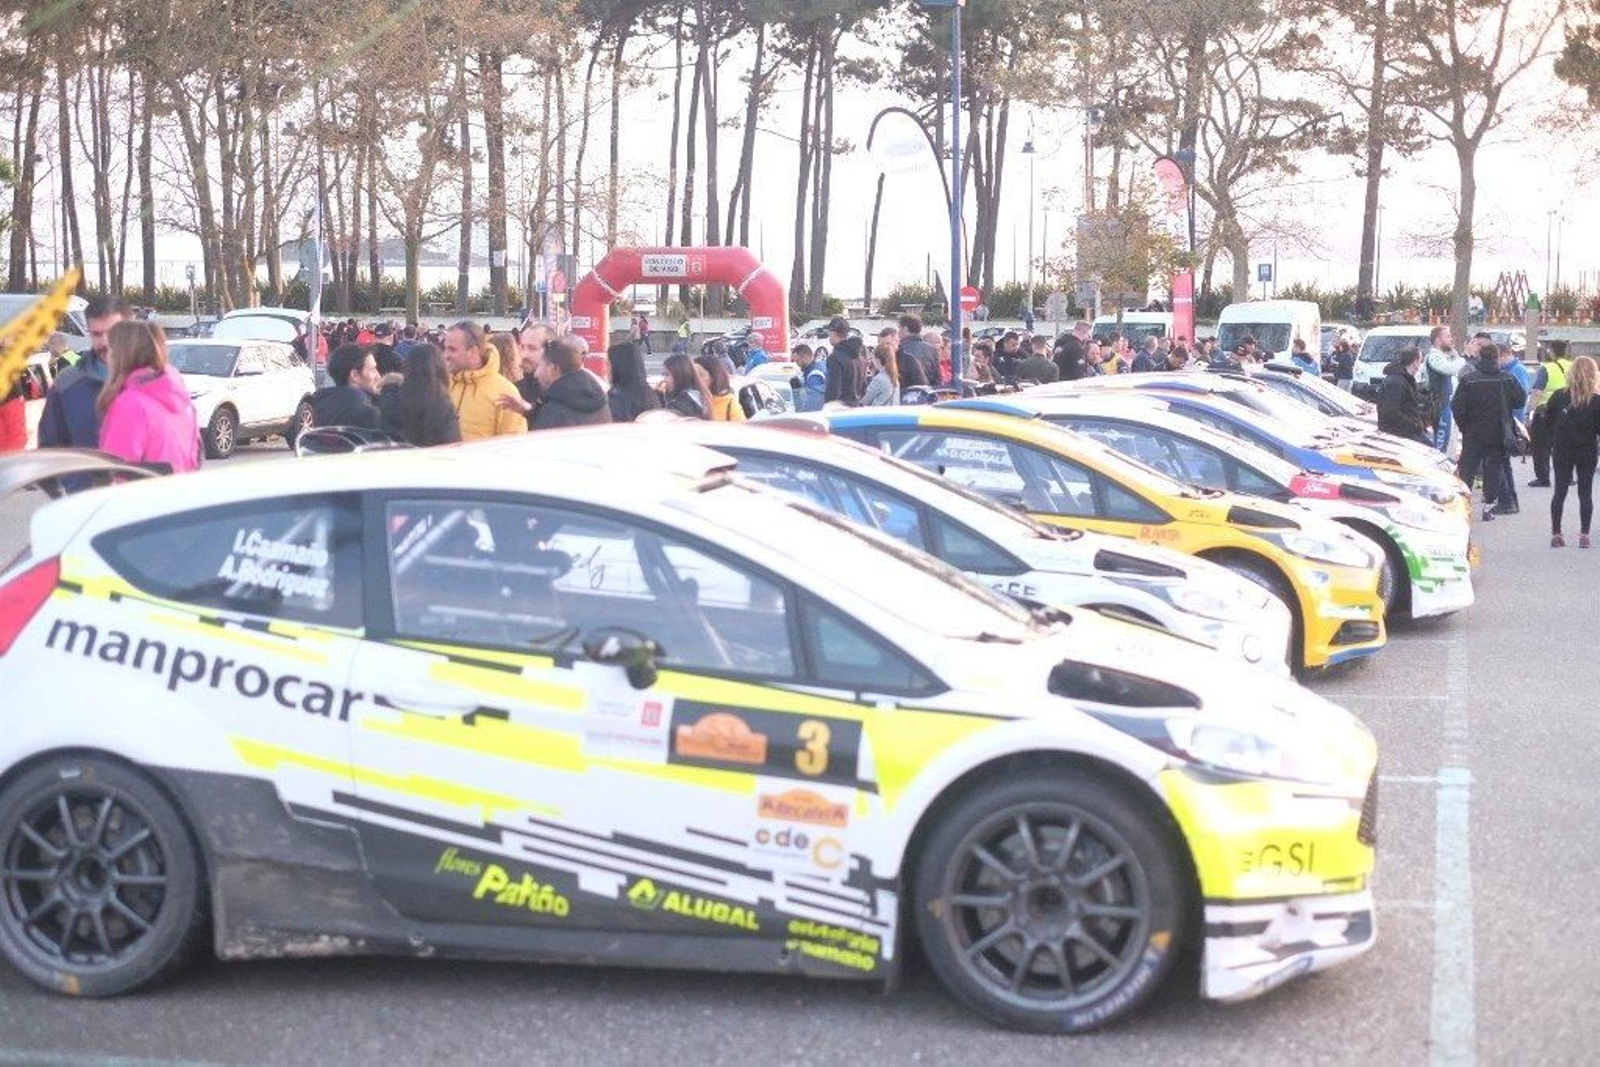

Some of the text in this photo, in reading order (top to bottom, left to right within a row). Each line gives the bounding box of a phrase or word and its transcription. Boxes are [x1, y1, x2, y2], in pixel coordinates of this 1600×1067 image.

[45, 617, 364, 722] manprocar
[794, 719, 832, 776] 3
[662, 891, 760, 931] ALUGAL
